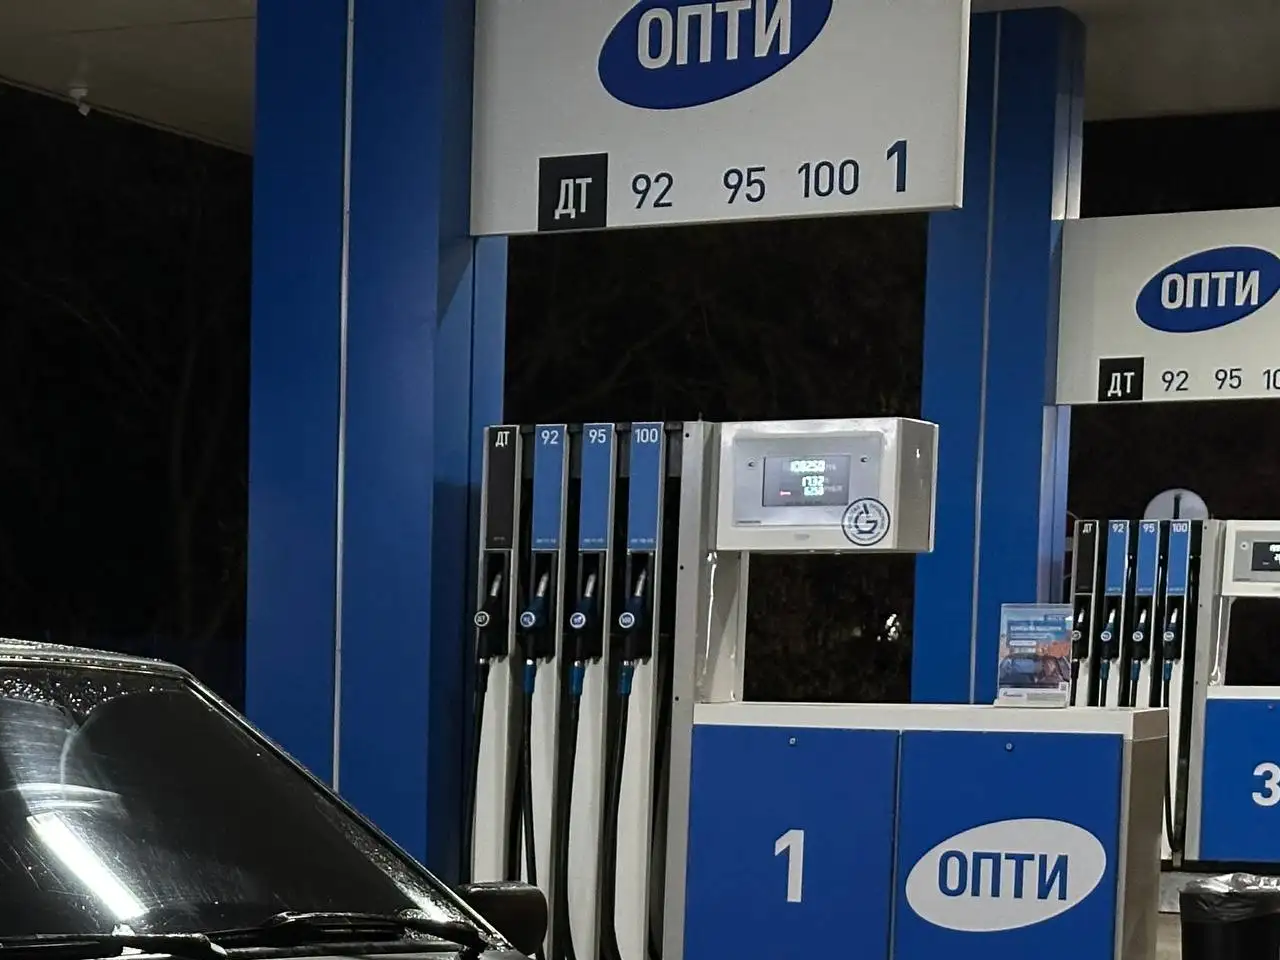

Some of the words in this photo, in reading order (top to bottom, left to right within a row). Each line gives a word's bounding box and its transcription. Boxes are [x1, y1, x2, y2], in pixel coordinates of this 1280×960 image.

[637, 0, 792, 70] ОПТИ
[554, 177, 593, 220] ДТ
[631, 171, 674, 209] 92
[723, 166, 766, 204] 95
[797, 158, 860, 199] 100
[886, 139, 908, 192] 1
[1160, 270, 1260, 310] ОПТИ
[1107, 371, 1136, 398] ДТ
[1161, 370, 1190, 392] 92
[1214, 368, 1243, 390] 95
[1262, 368, 1280, 390] 10
[494, 430, 511, 448] ДТ
[540, 429, 560, 445] 92
[588, 428, 608, 444] 95
[634, 427, 660, 444] 100
[1082, 523, 1093, 534] ДТ
[1112, 522, 1124, 533] 92
[1142, 522, 1155, 533] 95
[1172, 522, 1188, 533] 100
[1252, 762, 1280, 807] 3
[774, 828, 805, 902] 1
[938, 849, 1069, 901] ОПТИ
